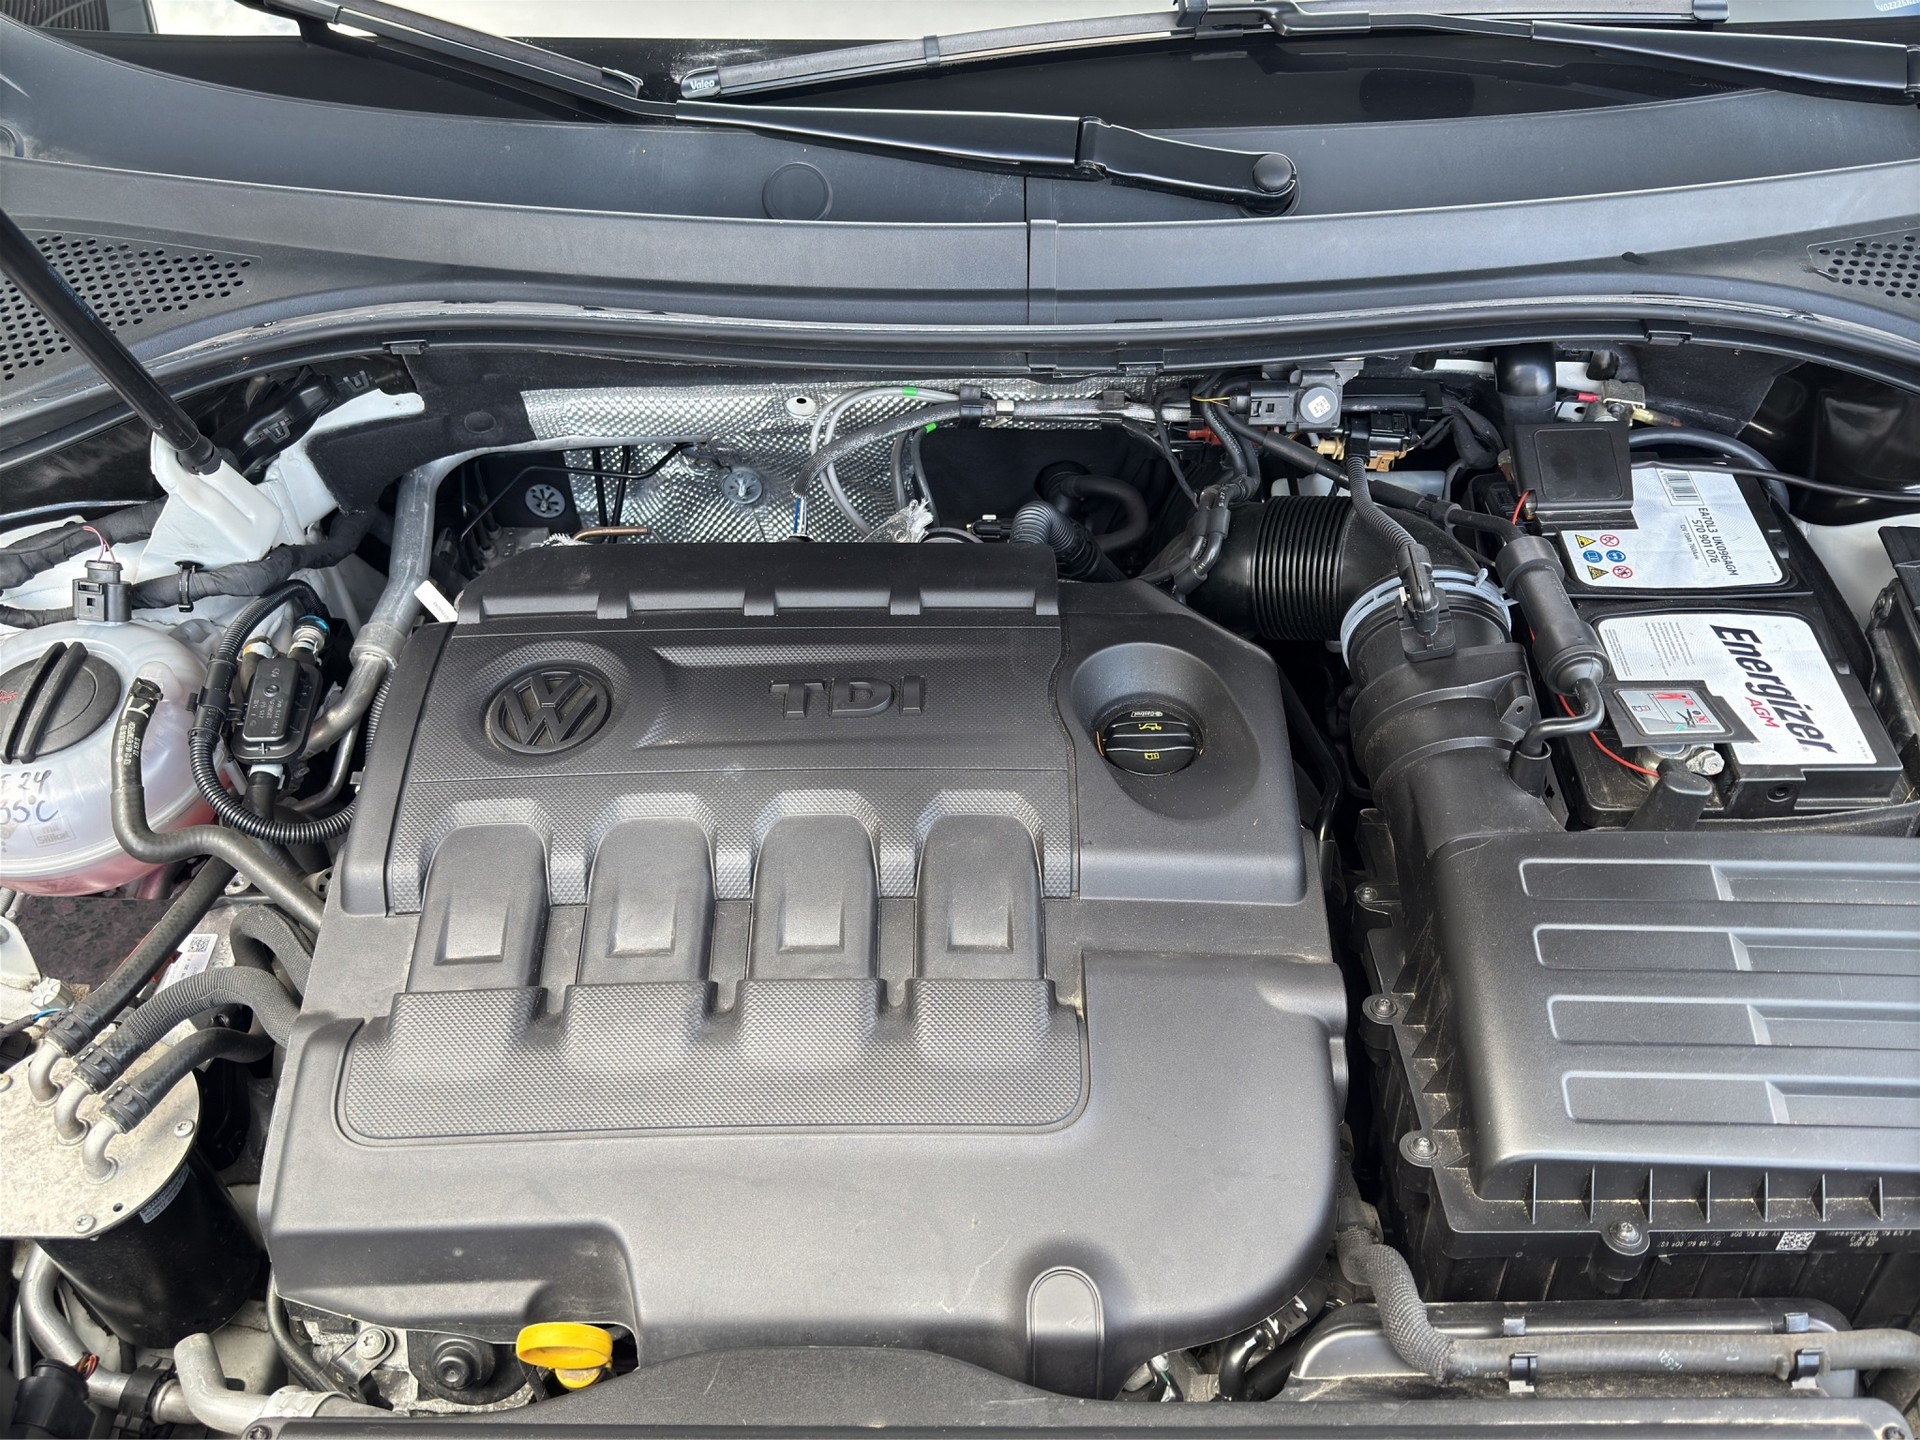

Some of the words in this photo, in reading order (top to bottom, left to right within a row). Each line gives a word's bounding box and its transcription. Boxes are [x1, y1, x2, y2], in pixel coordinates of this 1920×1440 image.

[690, 79, 715, 91] Valeo
[1691, 519, 1706, 533] 570
[1699, 534, 1712, 548] 901
[1706, 550, 1720, 563] 076
[1698, 507, 1719, 533] EA70L3
[1712, 536, 1739, 576] UK096AGM
[769, 675, 926, 719] TDI
[1709, 624, 1838, 754] Energizer
[1744, 696, 1780, 729] AGM
